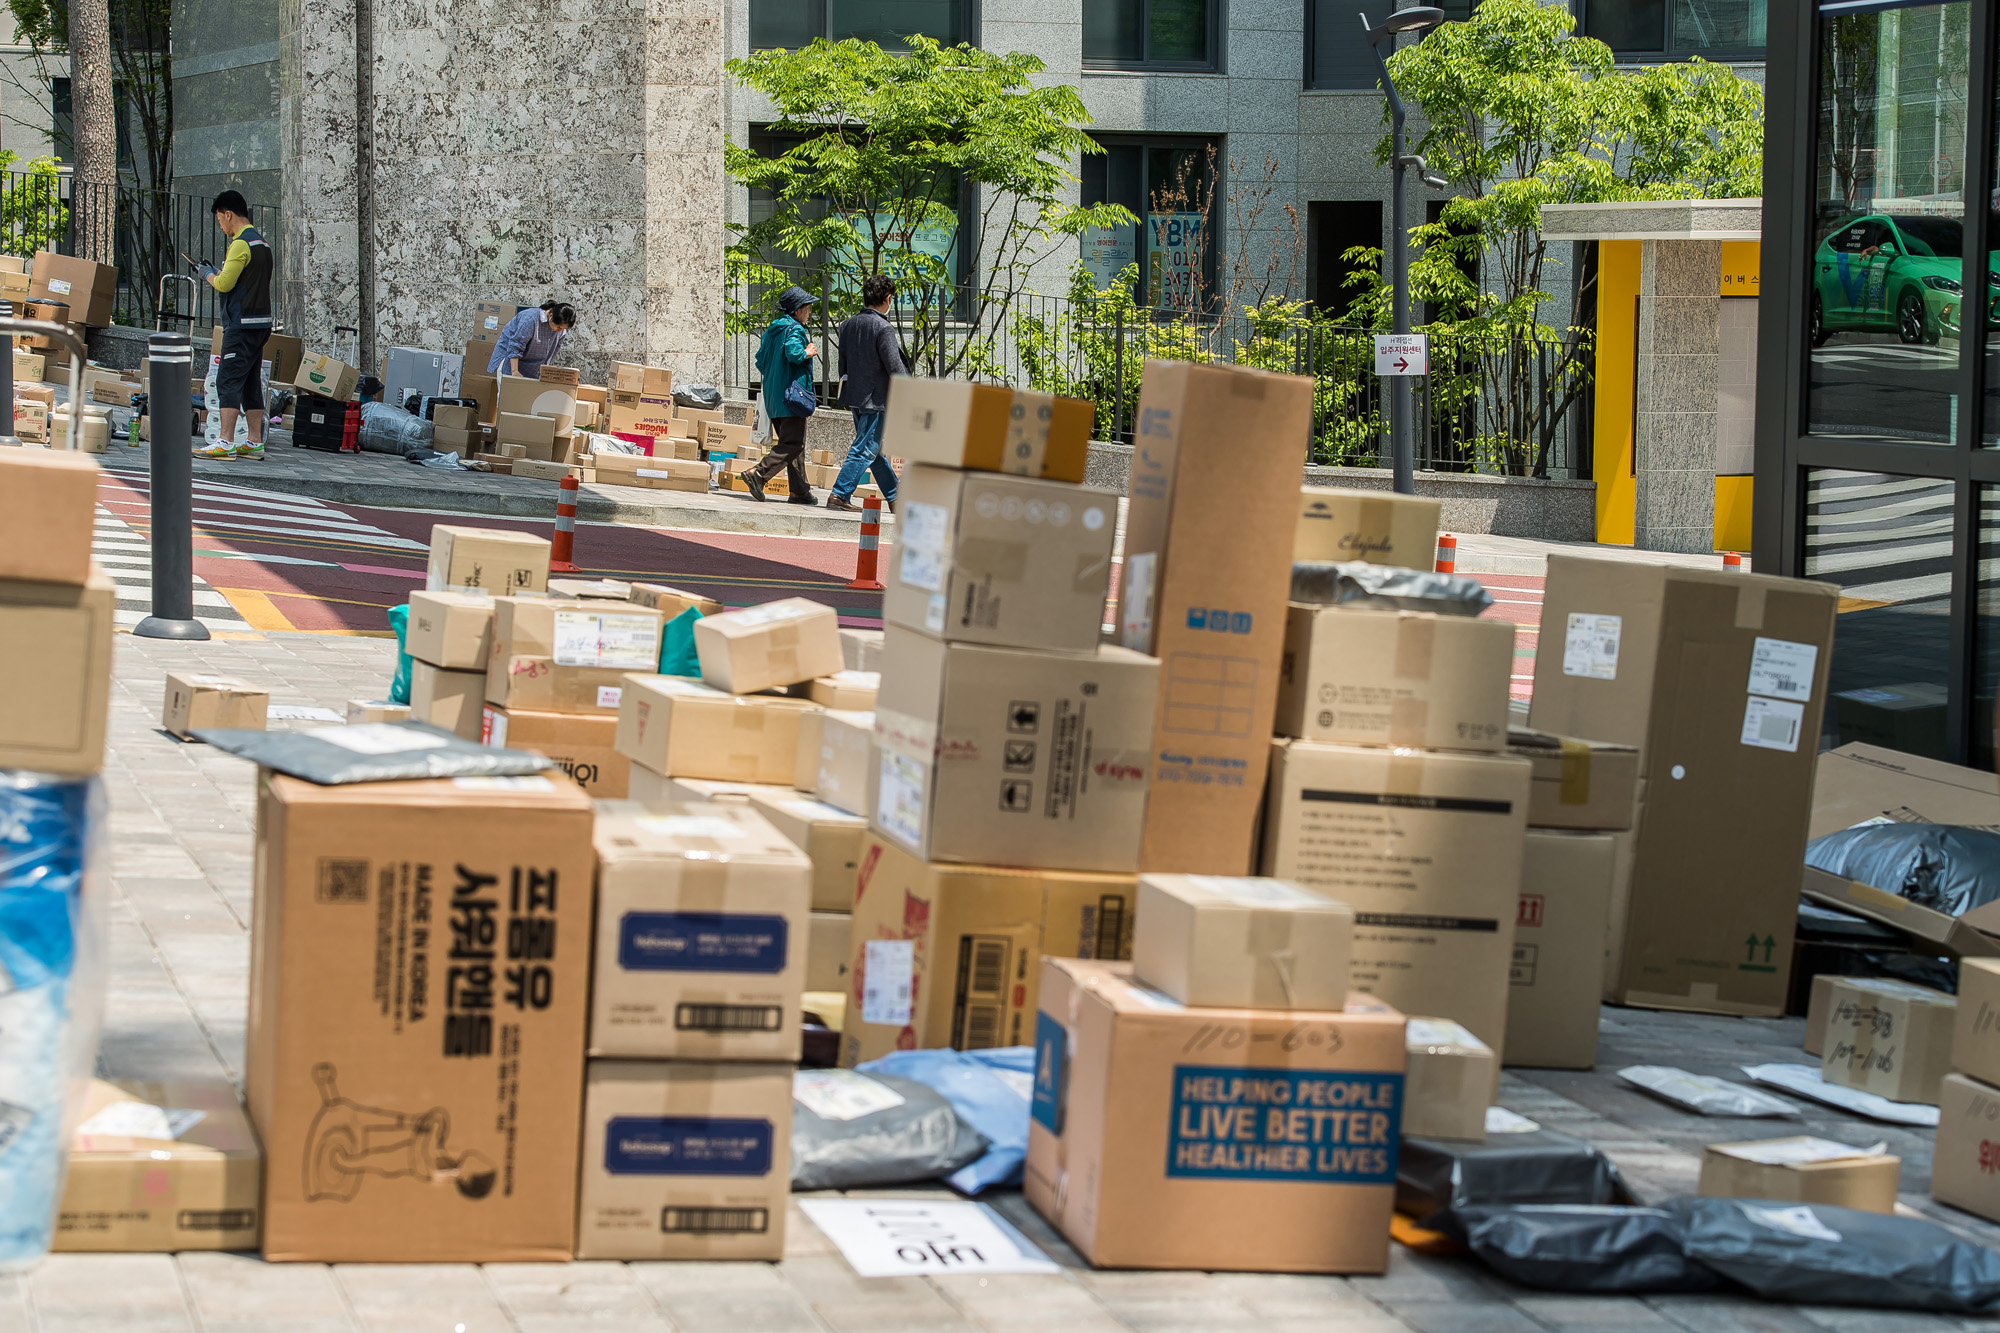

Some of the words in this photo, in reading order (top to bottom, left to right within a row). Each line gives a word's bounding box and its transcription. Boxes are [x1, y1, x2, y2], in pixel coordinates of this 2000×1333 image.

[915, 233, 947, 243] 프로그램
[1097, 239, 1118, 247] 영어전문
[1150, 219, 1201, 247] YBM
[1173, 251, 1199, 267] 010
[1380, 345, 1422, 355] 입주지원센터
[634, 422, 668, 435] HUGGIES
[707, 426, 723, 434] kitty
[707, 433, 728, 441] bunny
[412, 862, 432, 924] MADE
[413, 927, 430, 949] IN
[442, 862, 499, 1059] 샤워핸들
[408, 952, 429, 1024] KOREA
[1182, 1022, 1346, 1055] 110-603
[1181, 1075, 1292, 1106] HELPING
[1296, 1078, 1395, 1109] PEOPLE
[1178, 1104, 1257, 1140] LIVE
[1263, 1107, 1391, 1146] BETTER
[1175, 1142, 1314, 1172] HEALTHIER
[1316, 1145, 1389, 1175] LIVES
